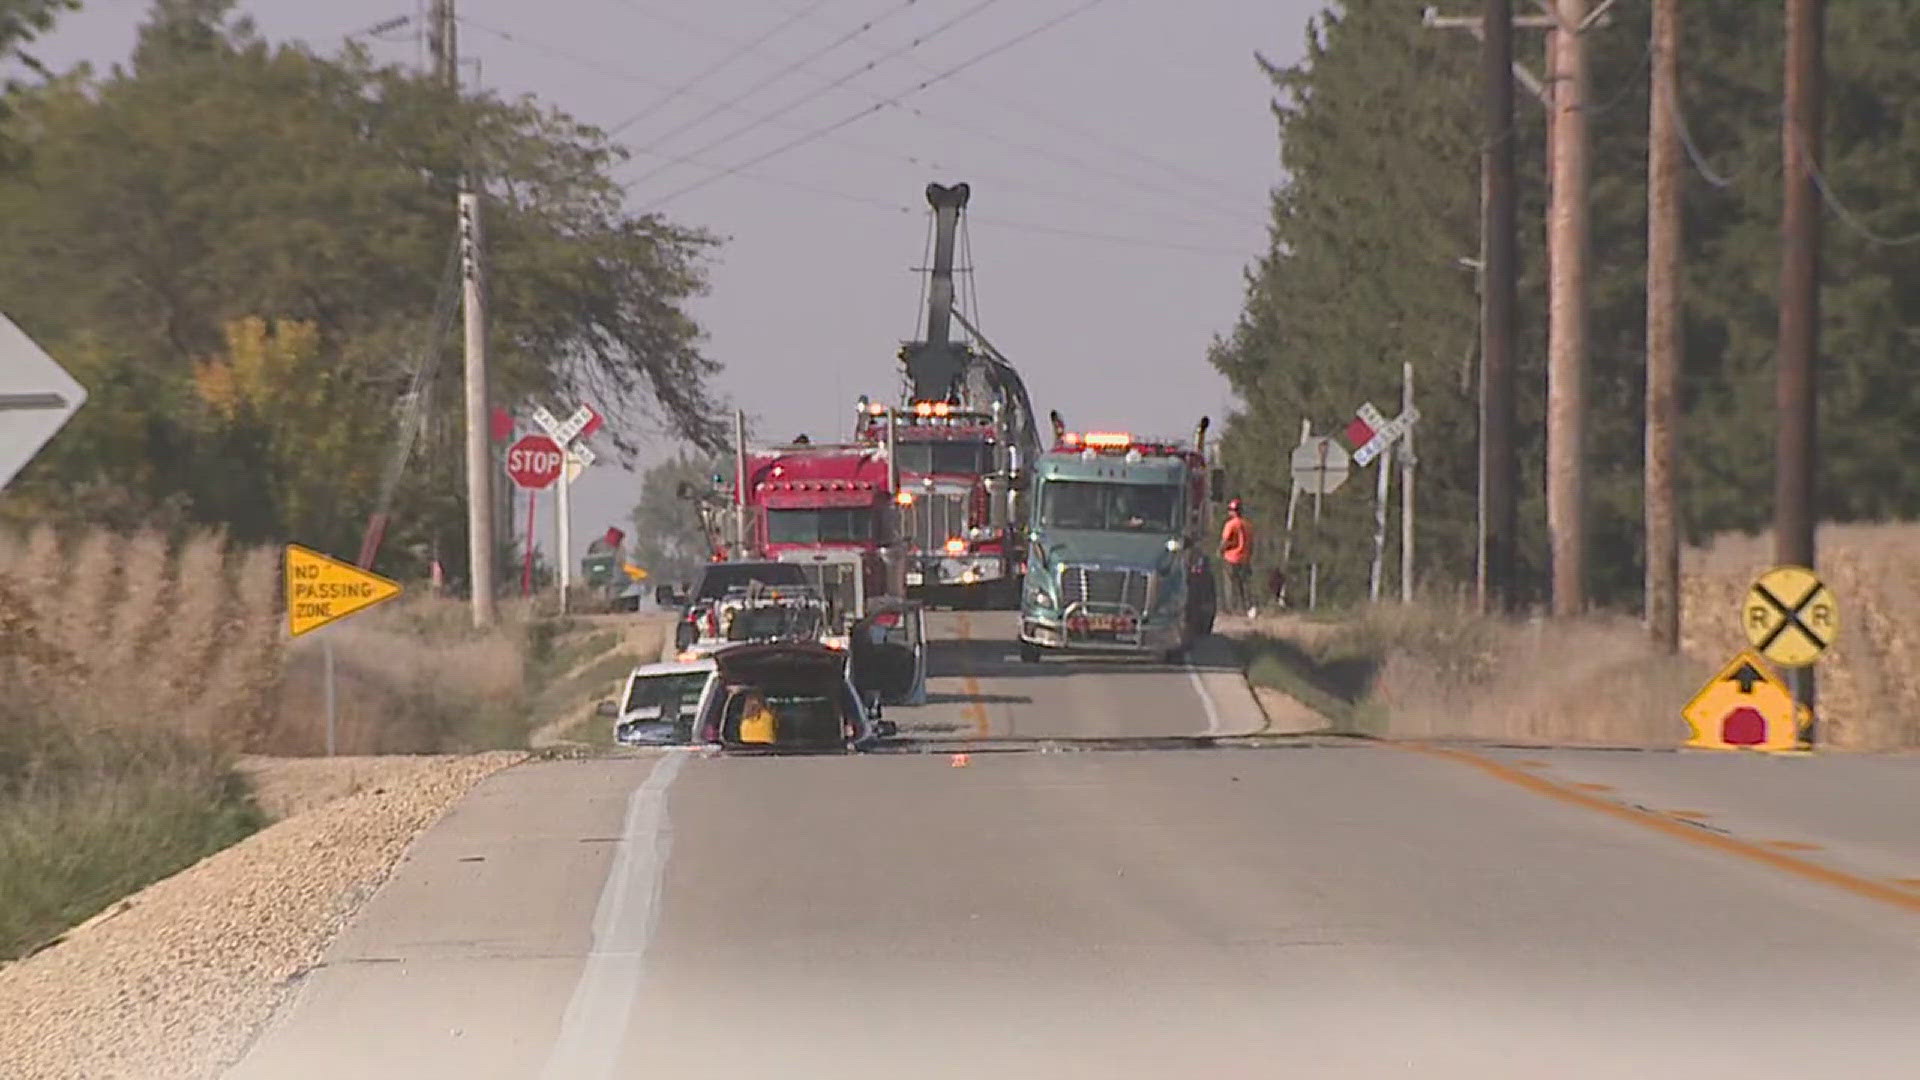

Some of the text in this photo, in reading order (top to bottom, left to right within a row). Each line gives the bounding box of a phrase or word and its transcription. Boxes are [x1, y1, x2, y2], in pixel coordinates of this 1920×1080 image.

[510, 450, 560, 473] STOP
[295, 564, 319, 579] NO
[295, 582, 372, 598] PASSING
[296, 602, 332, 618] ZONE
[1750, 604, 1832, 628] R R
